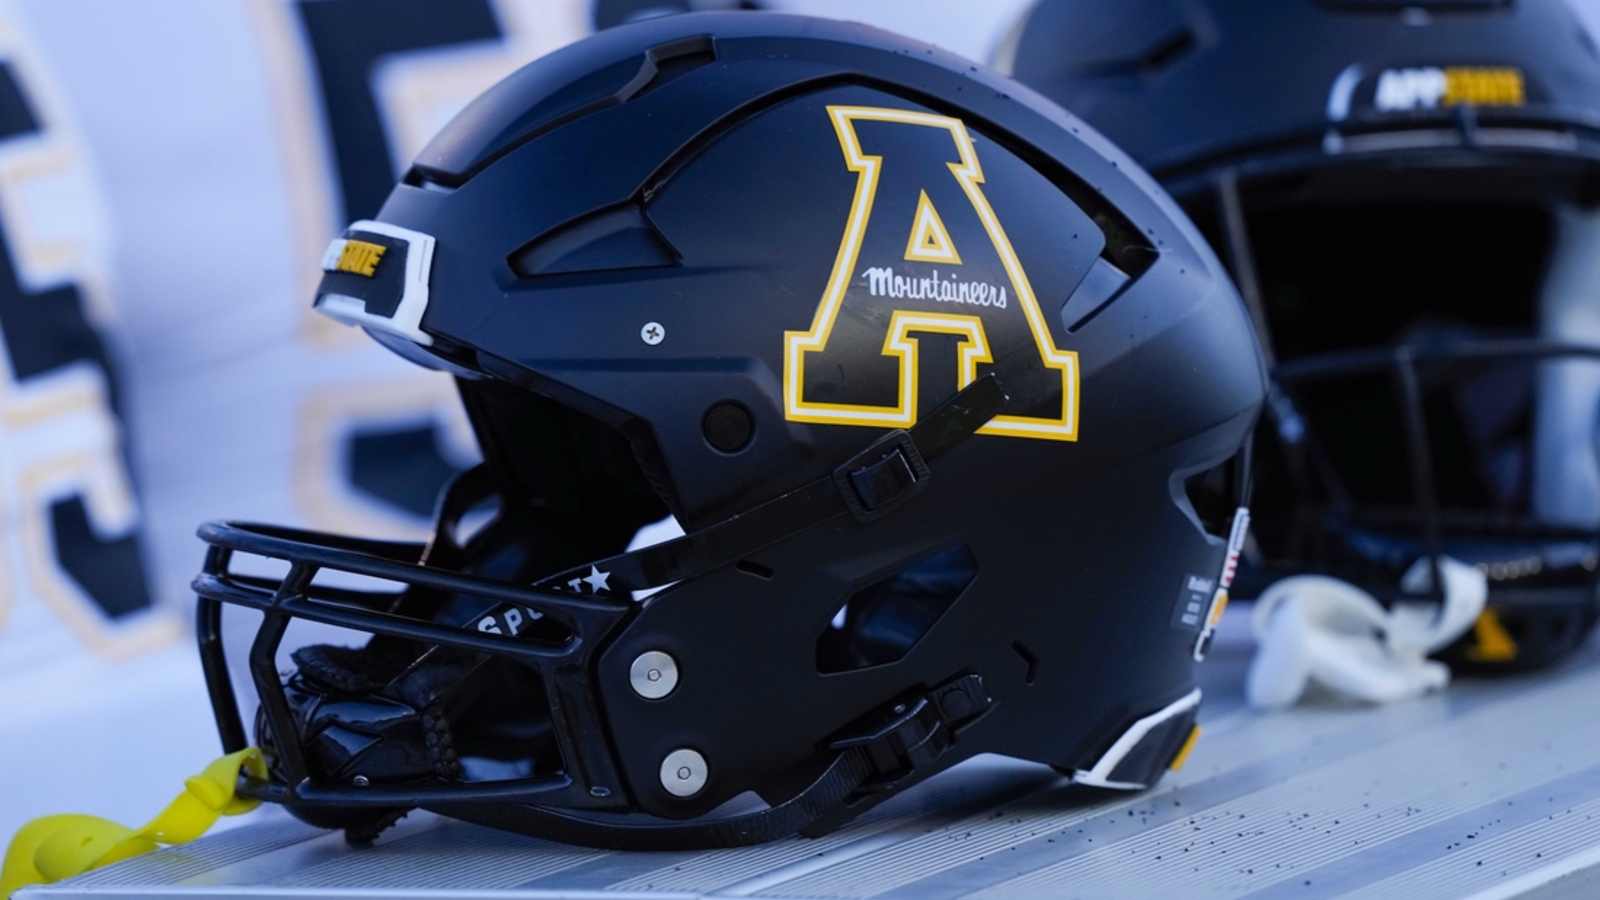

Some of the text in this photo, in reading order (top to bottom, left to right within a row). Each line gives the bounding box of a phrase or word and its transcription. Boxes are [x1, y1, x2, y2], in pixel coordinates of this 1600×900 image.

[783, 105, 1081, 441] A
[861, 266, 1007, 309] Mountaineers
[477, 577, 582, 635] SPT
